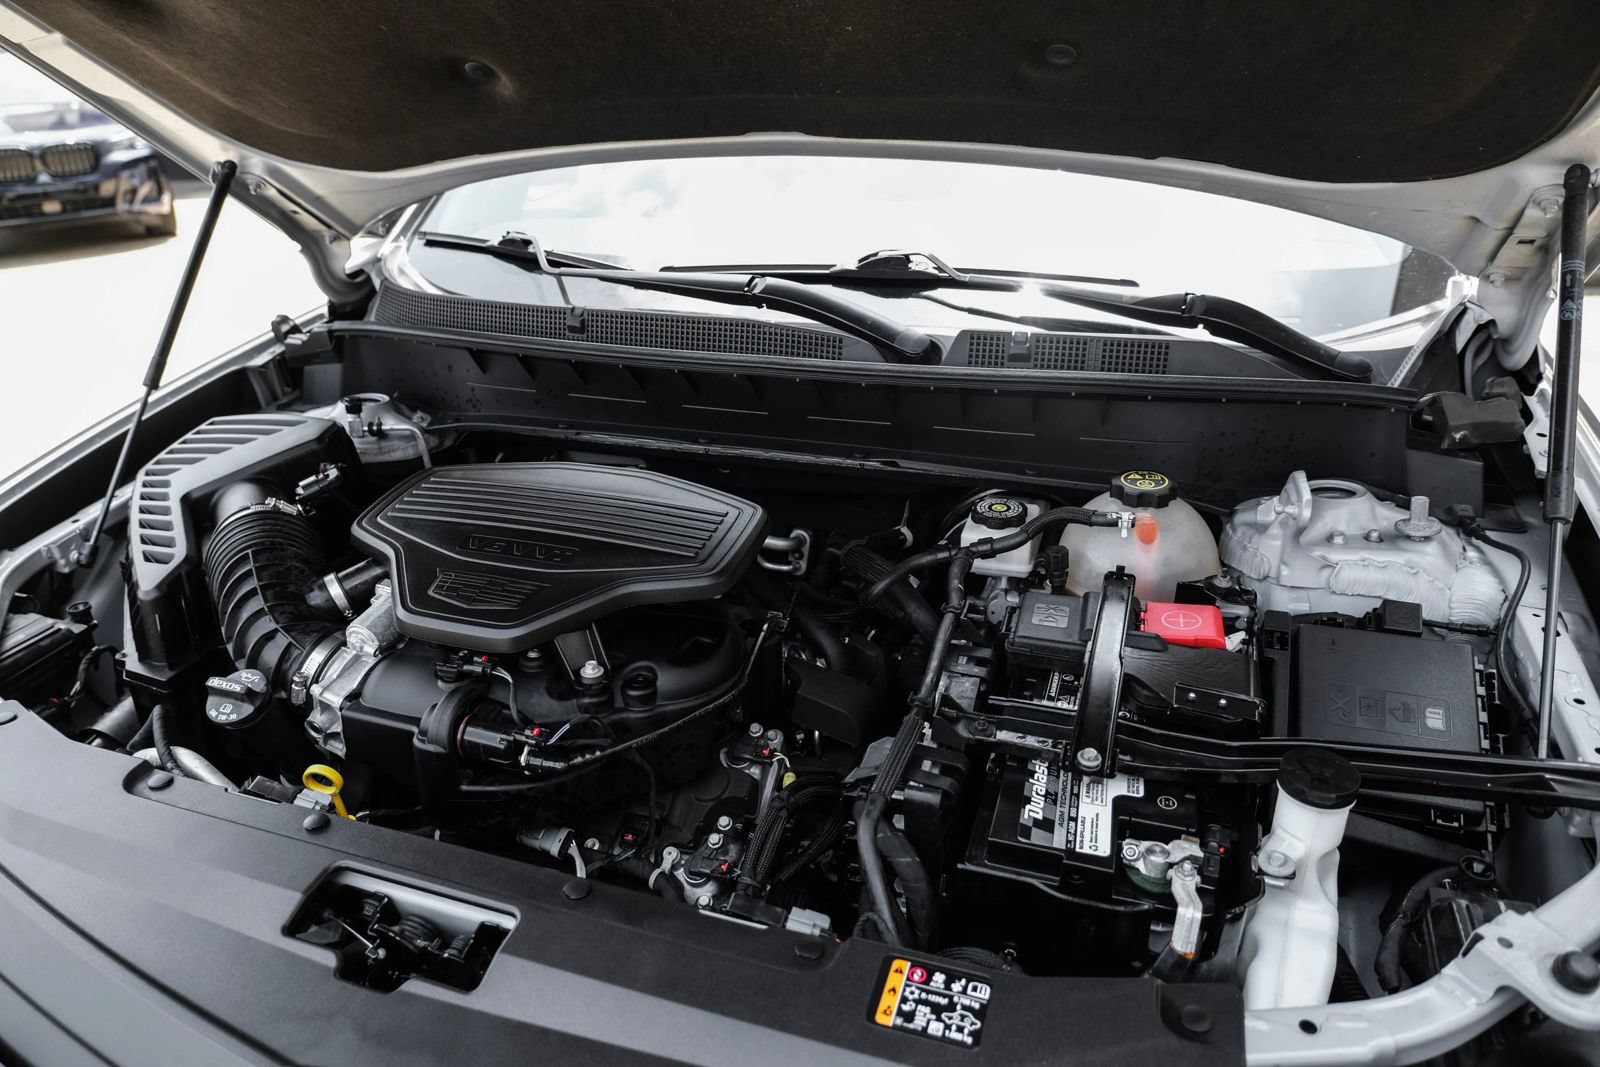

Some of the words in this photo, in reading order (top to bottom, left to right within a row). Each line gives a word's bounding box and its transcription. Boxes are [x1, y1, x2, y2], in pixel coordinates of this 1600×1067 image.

[208, 677, 243, 691] dexos
[217, 713, 237, 721] 5W-30
[1024, 759, 1049, 820] Duralast
[1060, 772, 1070, 808] TECHNOLO
[1058, 810, 1066, 828] AGM
[1078, 815, 1087, 850] NON-SPILLABLE
